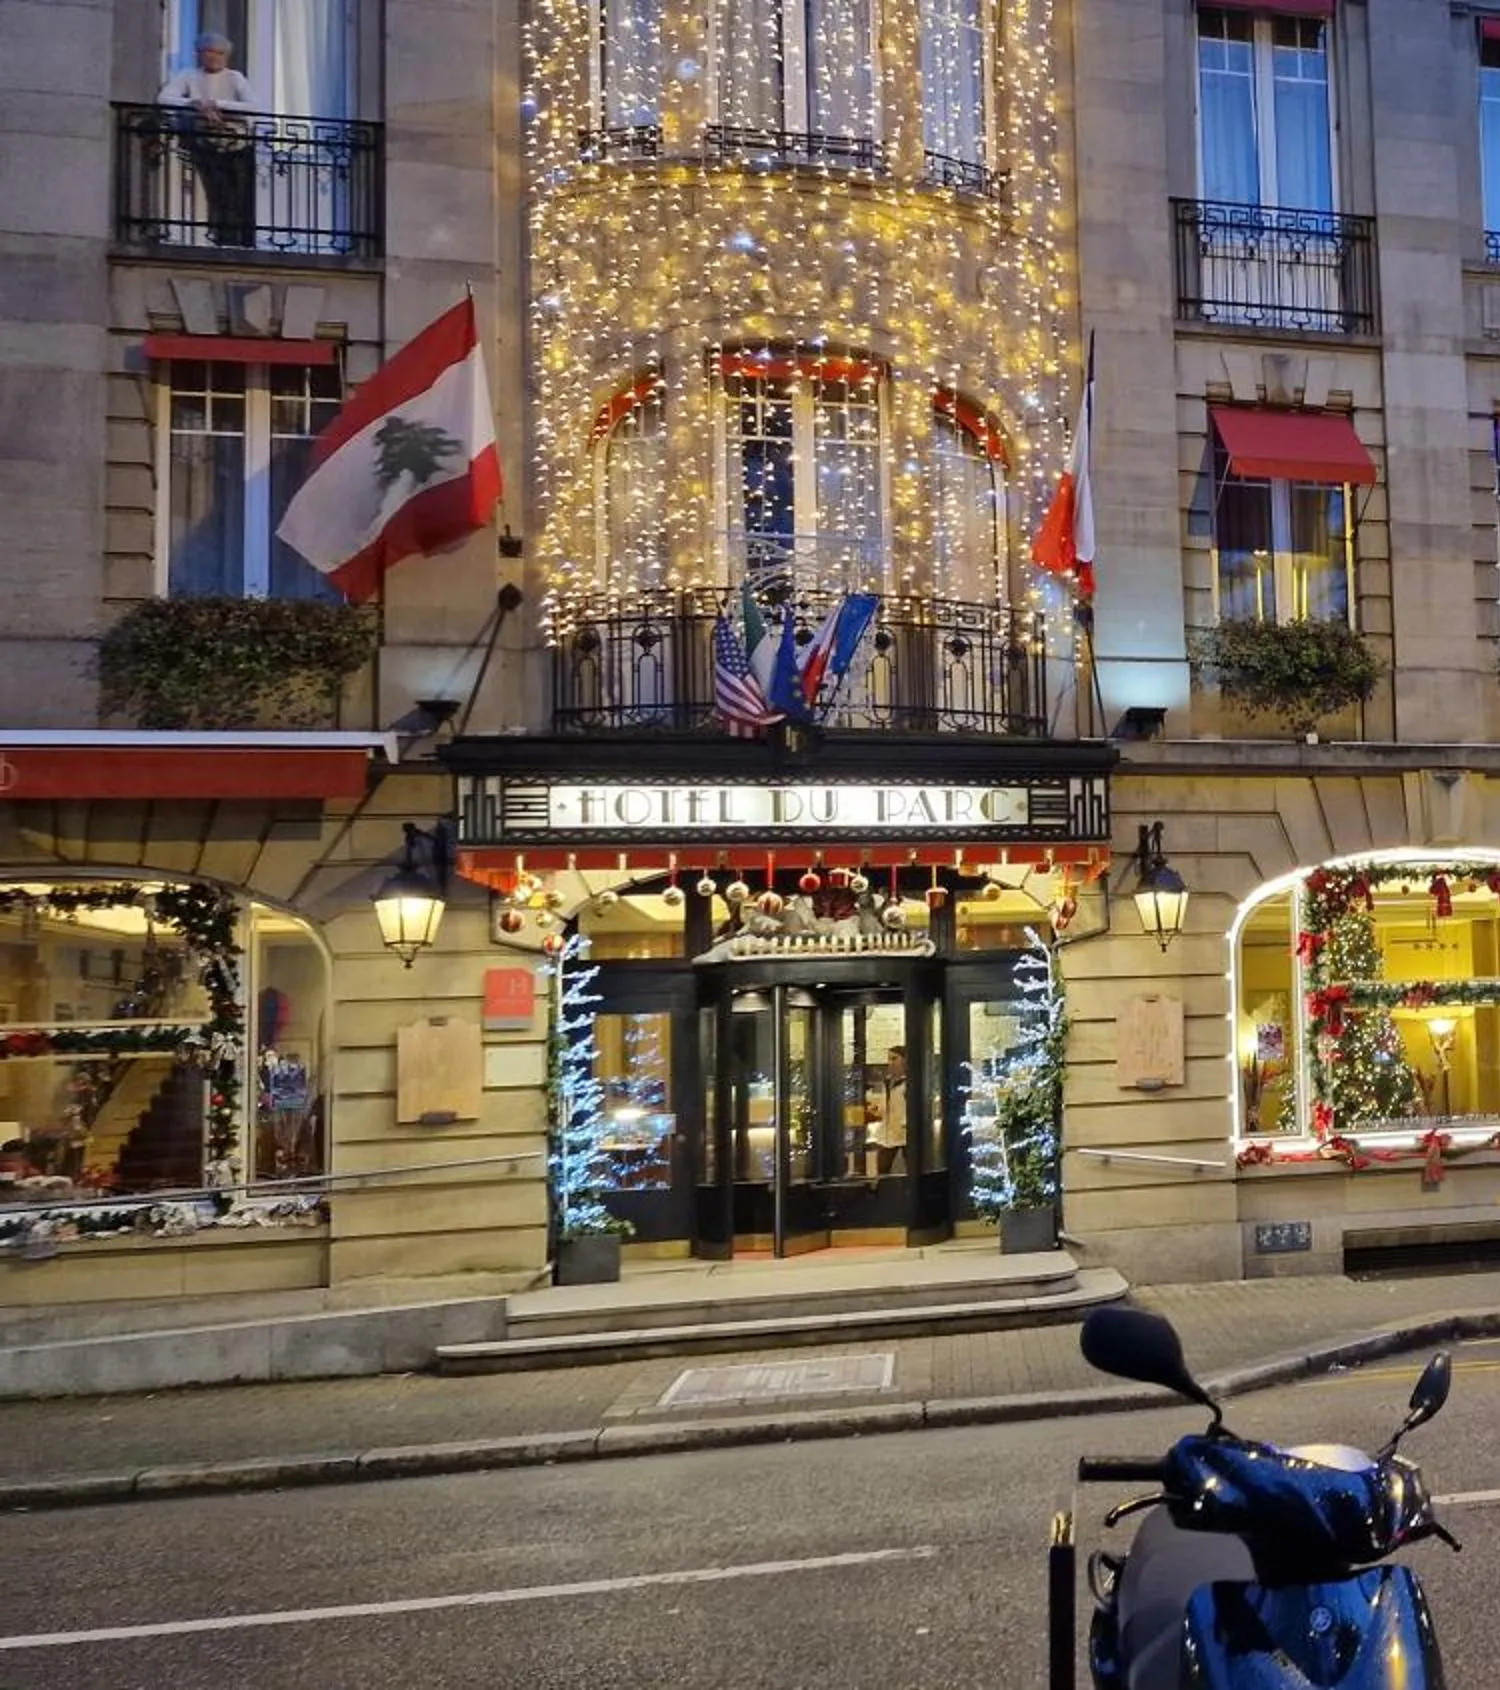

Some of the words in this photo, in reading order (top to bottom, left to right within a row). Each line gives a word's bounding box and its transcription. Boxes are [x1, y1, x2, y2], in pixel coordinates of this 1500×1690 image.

[578, 790, 745, 824] HOTEL
[768, 789, 839, 823] DU
[873, 789, 1011, 823] PARC
